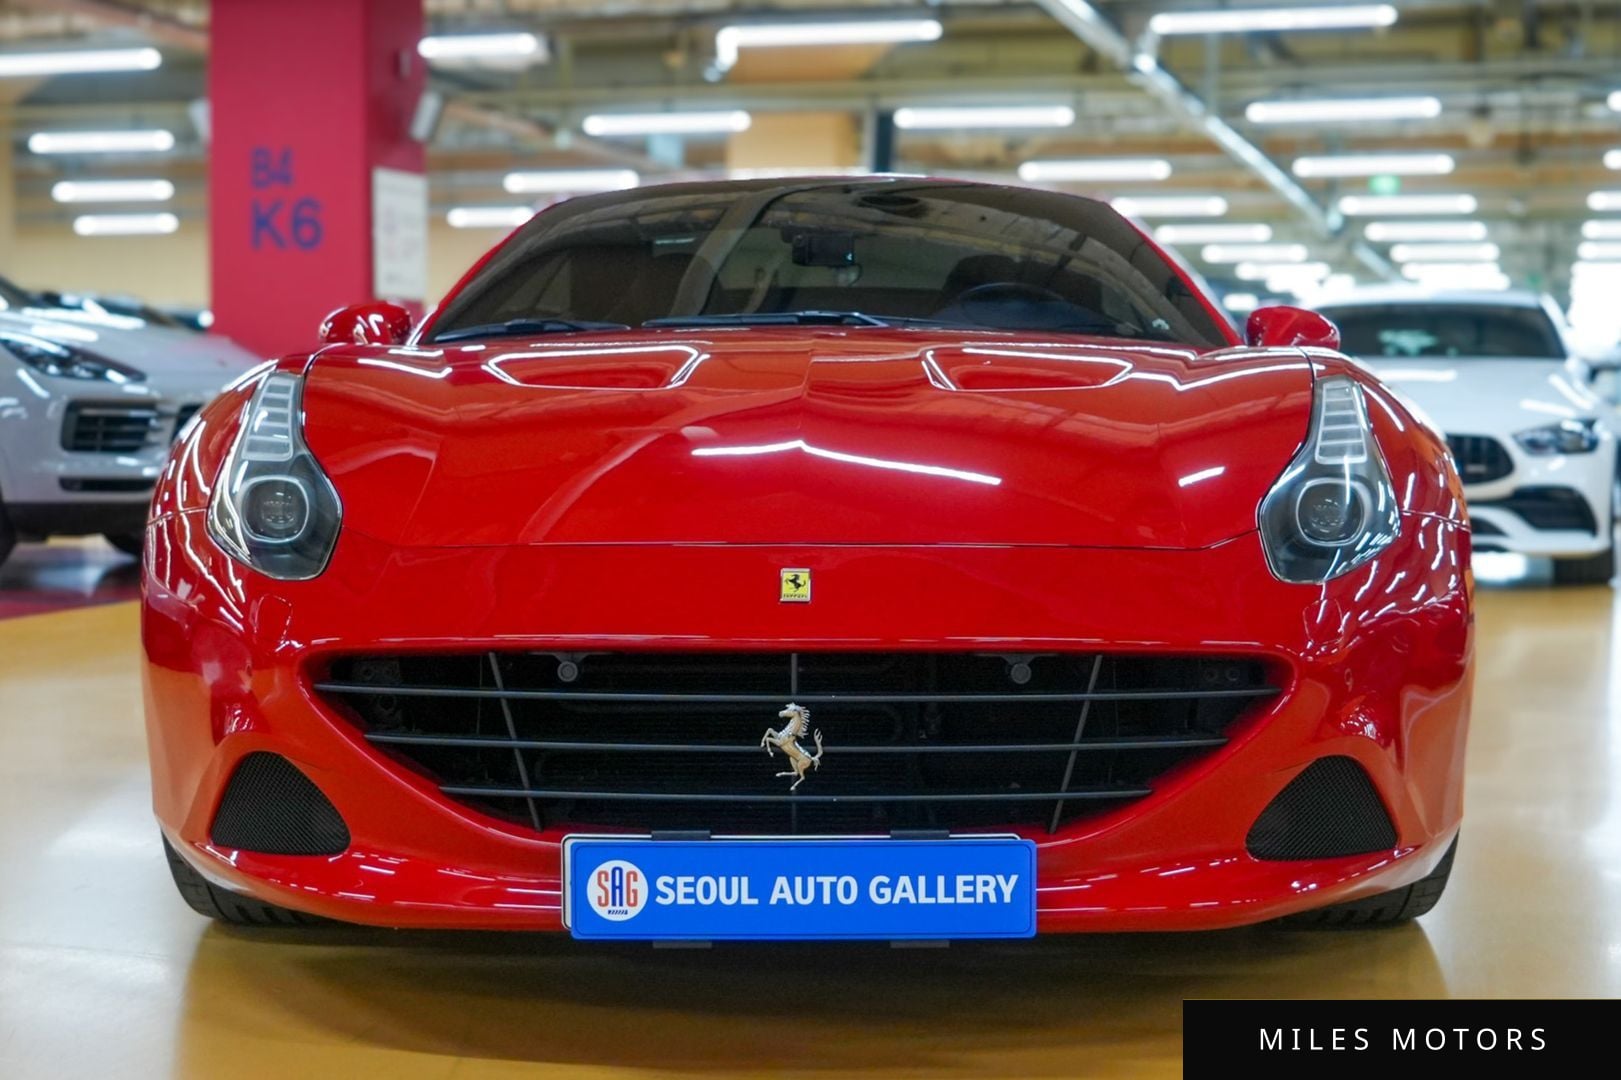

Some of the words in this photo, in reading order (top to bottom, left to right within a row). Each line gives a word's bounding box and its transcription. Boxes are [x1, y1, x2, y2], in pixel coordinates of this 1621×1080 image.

[251, 147, 293, 189] B4
[251, 197, 324, 251] K6
[597, 866, 638, 907] SAG
[655, 875, 759, 906] SEOUL
[769, 875, 858, 905] AUTO
[868, 874, 1019, 905] GALLERY
